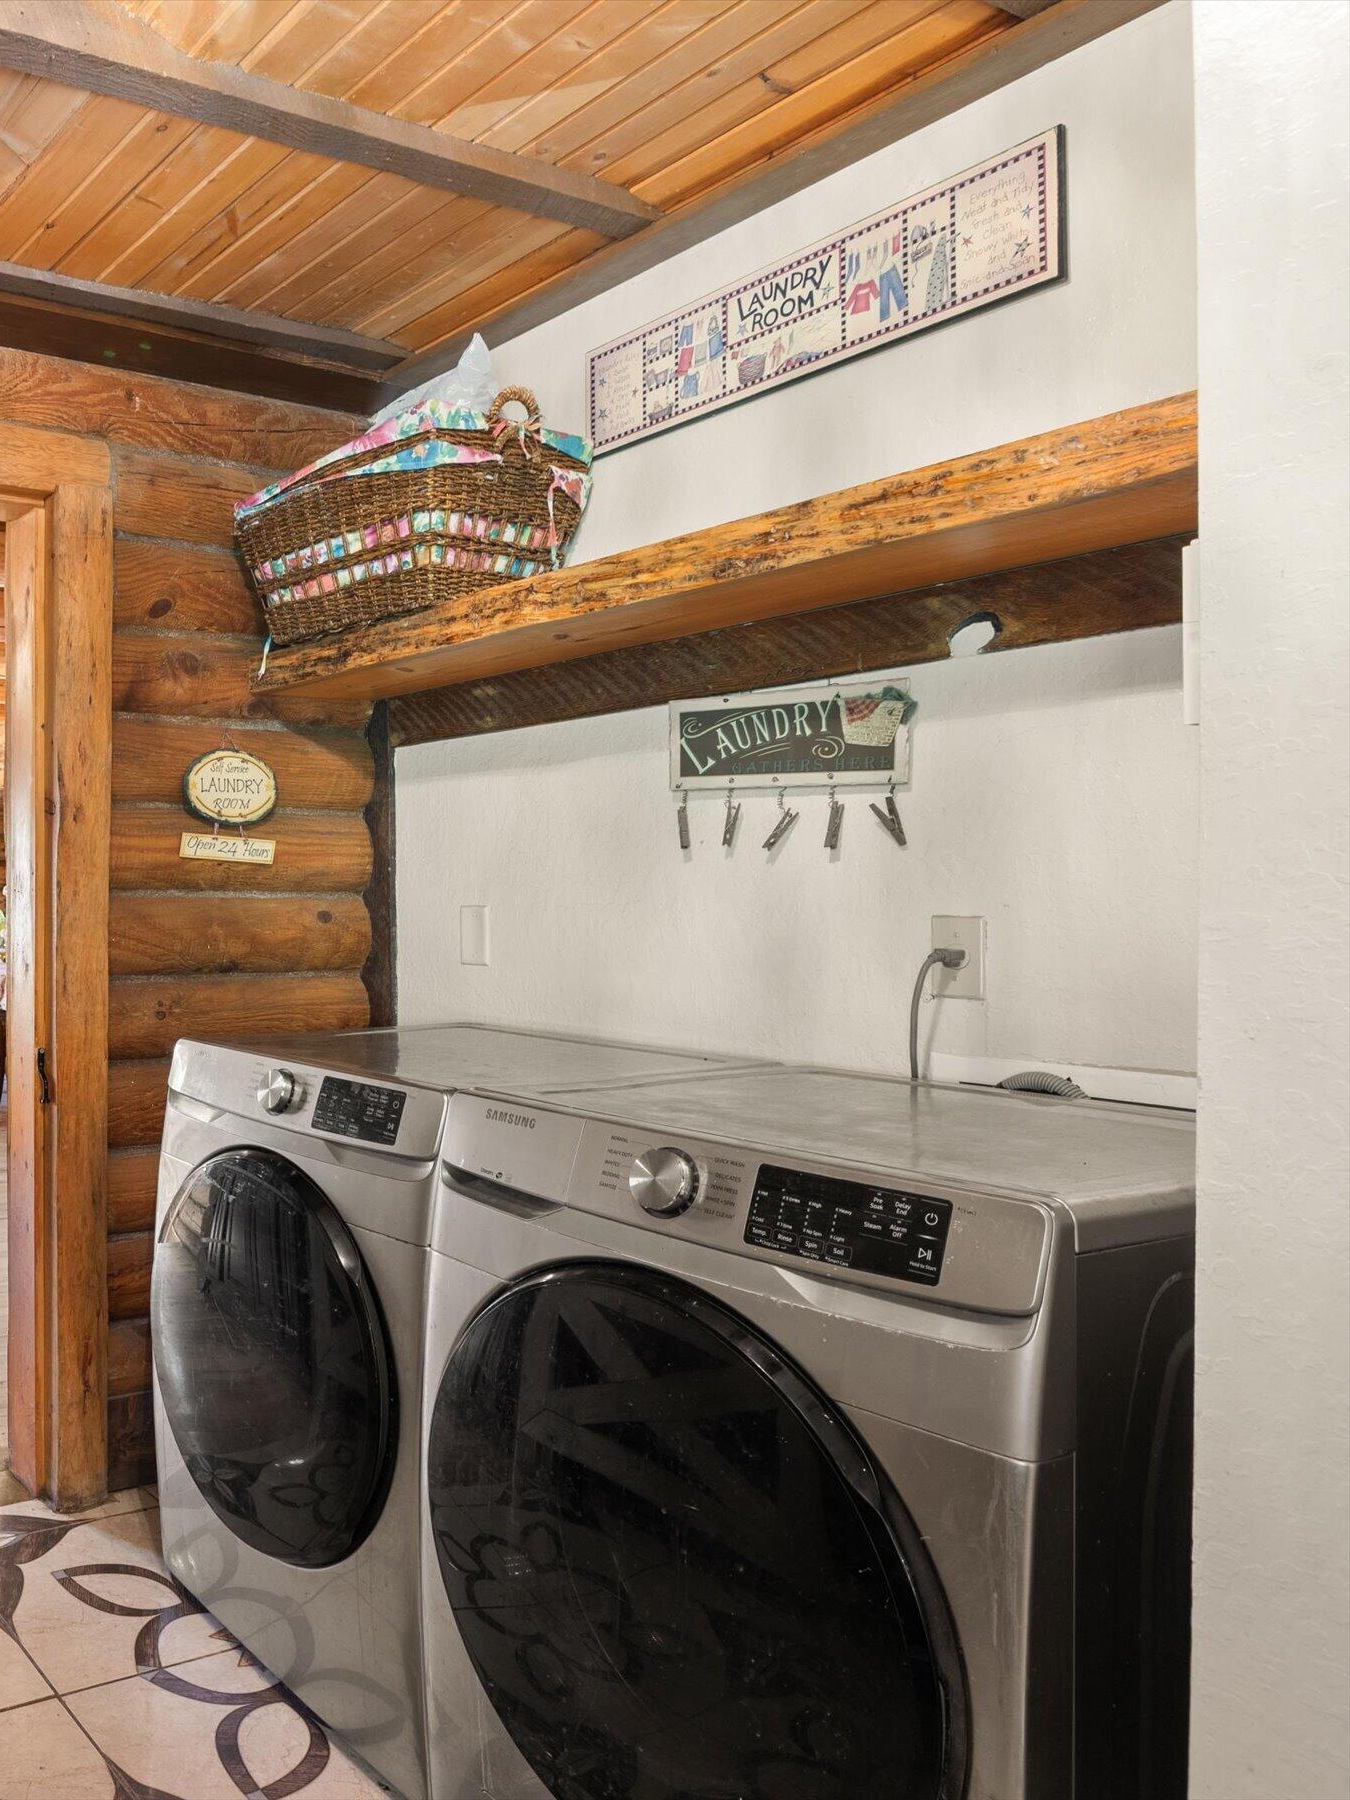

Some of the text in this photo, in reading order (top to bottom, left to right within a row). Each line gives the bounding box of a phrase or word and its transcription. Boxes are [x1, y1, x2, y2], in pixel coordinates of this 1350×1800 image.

[991, 194, 1008, 207] and
[737, 255, 832, 321] LAUNDRY
[752, 290, 814, 332] ROOM
[680, 697, 837, 775] LAUNDRY
[732, 755, 892, 775] GATHERS HERE
[200, 777, 263, 795] LAUNDRY
[213, 798, 251, 810] ROOM
[187, 835, 271, 859] Open 24 Hours
[485, 1108, 537, 1129] SAMSUNG
[895, 1201, 911, 1210] Delay
[864, 1221, 882, 1230] Steam
[890, 1224, 907, 1233] Alarm
[777, 1233, 792, 1242] Rinse
[805, 1240, 818, 1249] Spin
